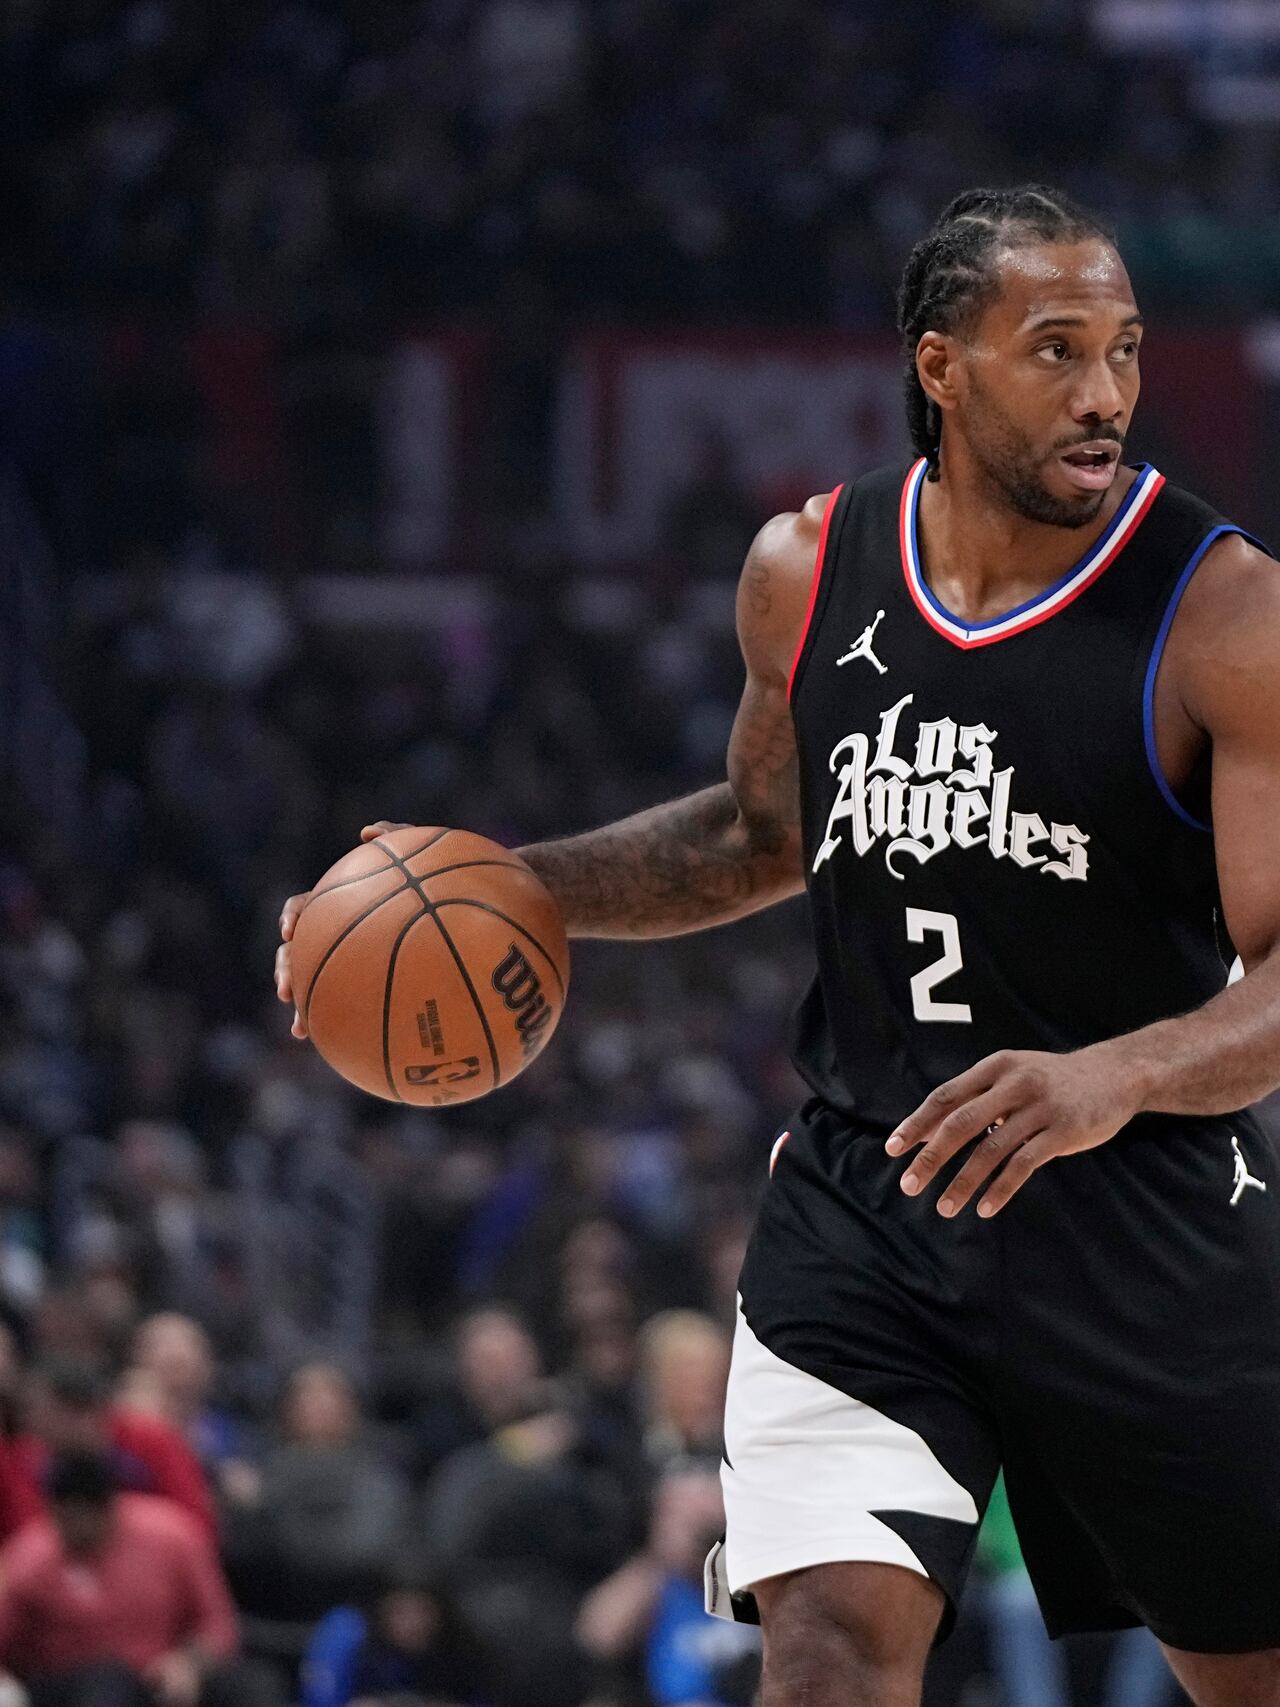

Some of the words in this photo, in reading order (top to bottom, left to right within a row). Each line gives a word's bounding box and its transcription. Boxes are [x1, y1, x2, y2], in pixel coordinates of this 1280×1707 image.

[866, 693, 998, 790] Los
[812, 731, 1091, 881] Angeles
[906, 907, 972, 1023] 2
